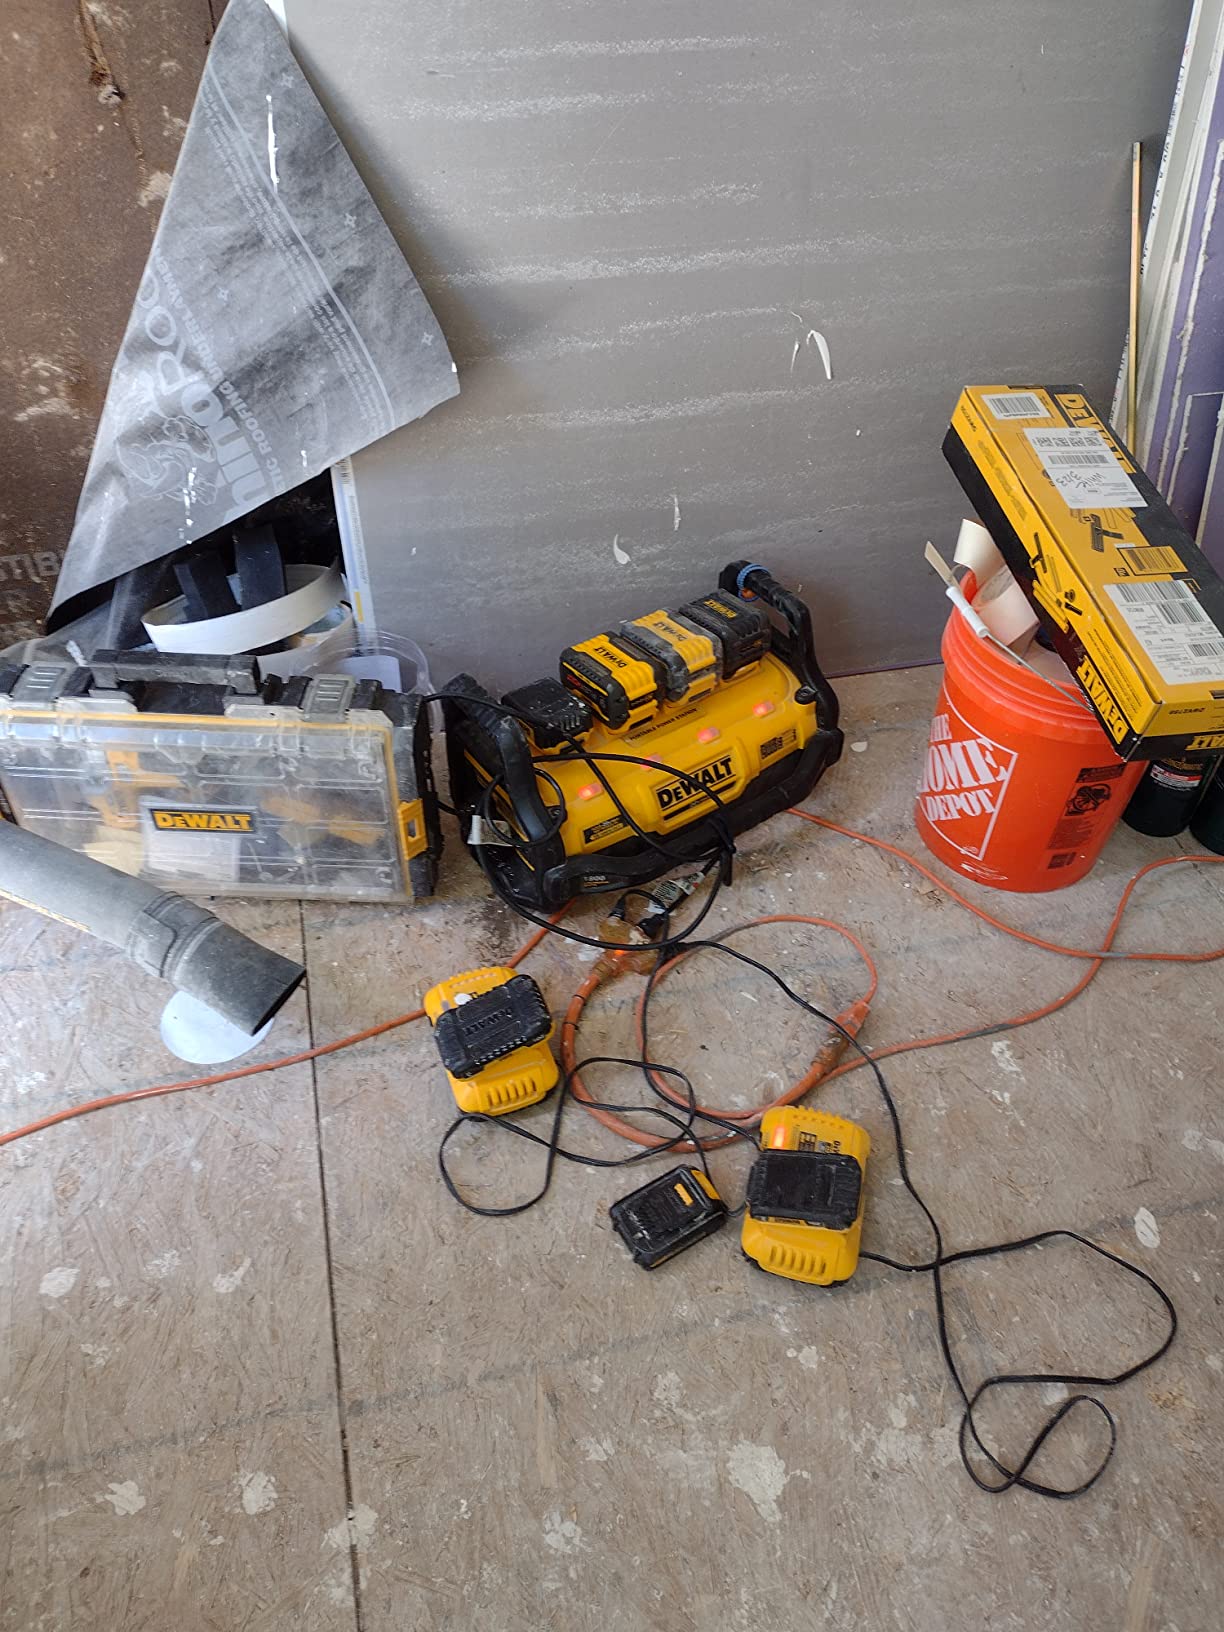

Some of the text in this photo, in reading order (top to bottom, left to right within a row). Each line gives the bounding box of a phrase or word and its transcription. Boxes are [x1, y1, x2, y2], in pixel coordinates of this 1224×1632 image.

[219, 380, 272, 461] ROOFING
[594, 646, 628, 669] DEWALT
[1077, 656, 1128, 744] DEWALT
[656, 756, 732, 809] DEWALT
[154, 810, 253, 832] DEWALT
[924, 788, 997, 822] DEPOT
